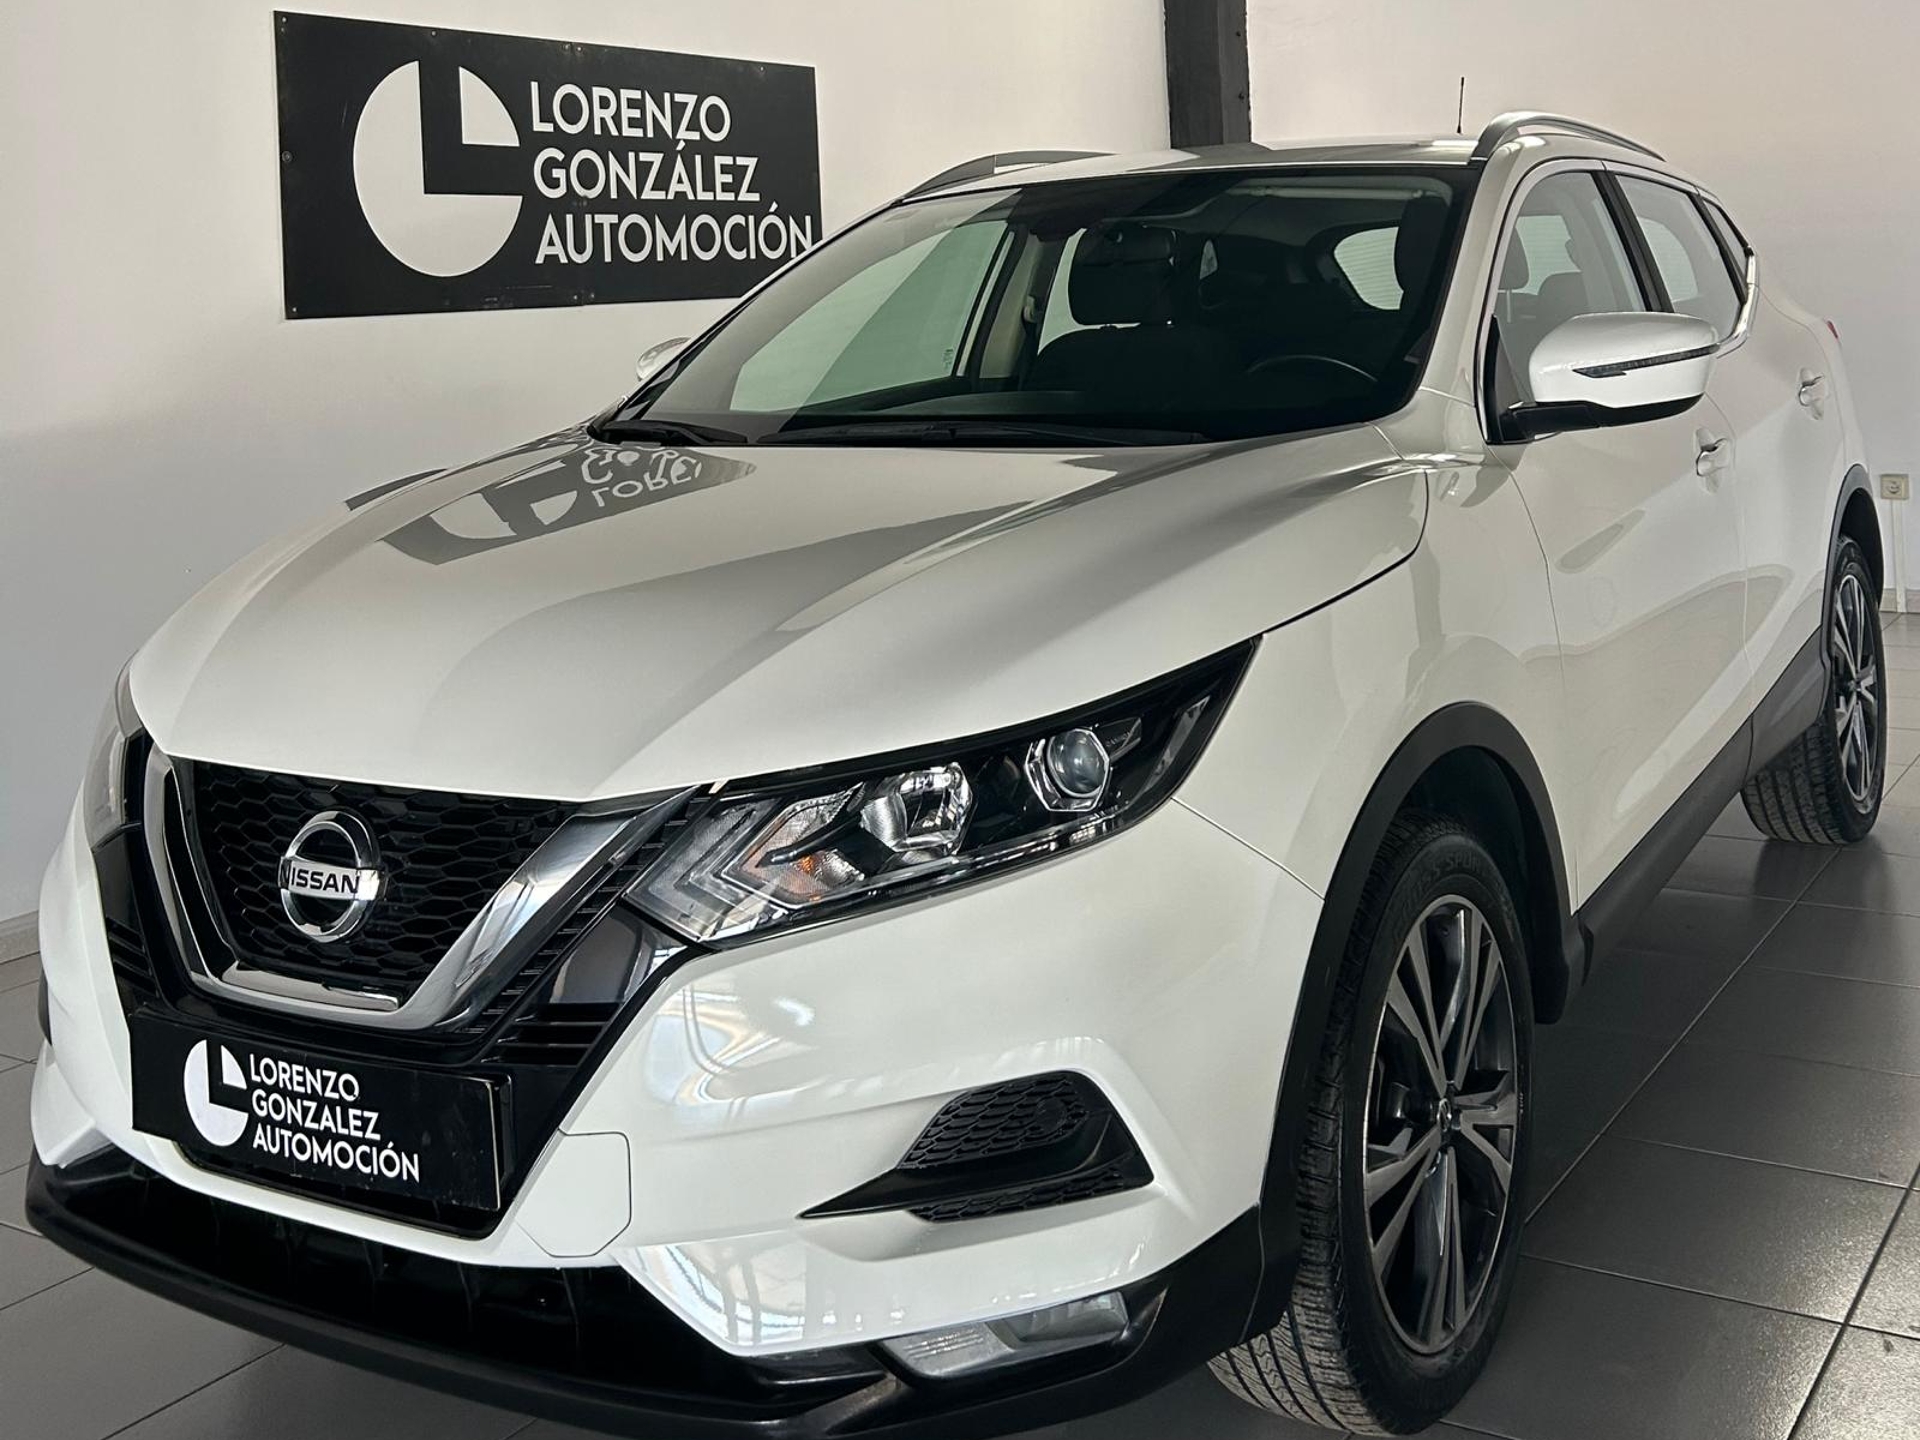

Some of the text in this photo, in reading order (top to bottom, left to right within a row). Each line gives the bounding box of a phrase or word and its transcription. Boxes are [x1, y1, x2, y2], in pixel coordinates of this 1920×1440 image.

[530, 80, 731, 142] LORENZO
[533, 139, 761, 202] GONZÁLEZ
[534, 200, 813, 264] AUTOMOCIÓN
[279, 866, 360, 894] NISSAN
[249, 1053, 360, 1102] LORENZO
[251, 1088, 381, 1141] GONZALEZ
[252, 1122, 420, 1184] AUTOMOCIÓN
